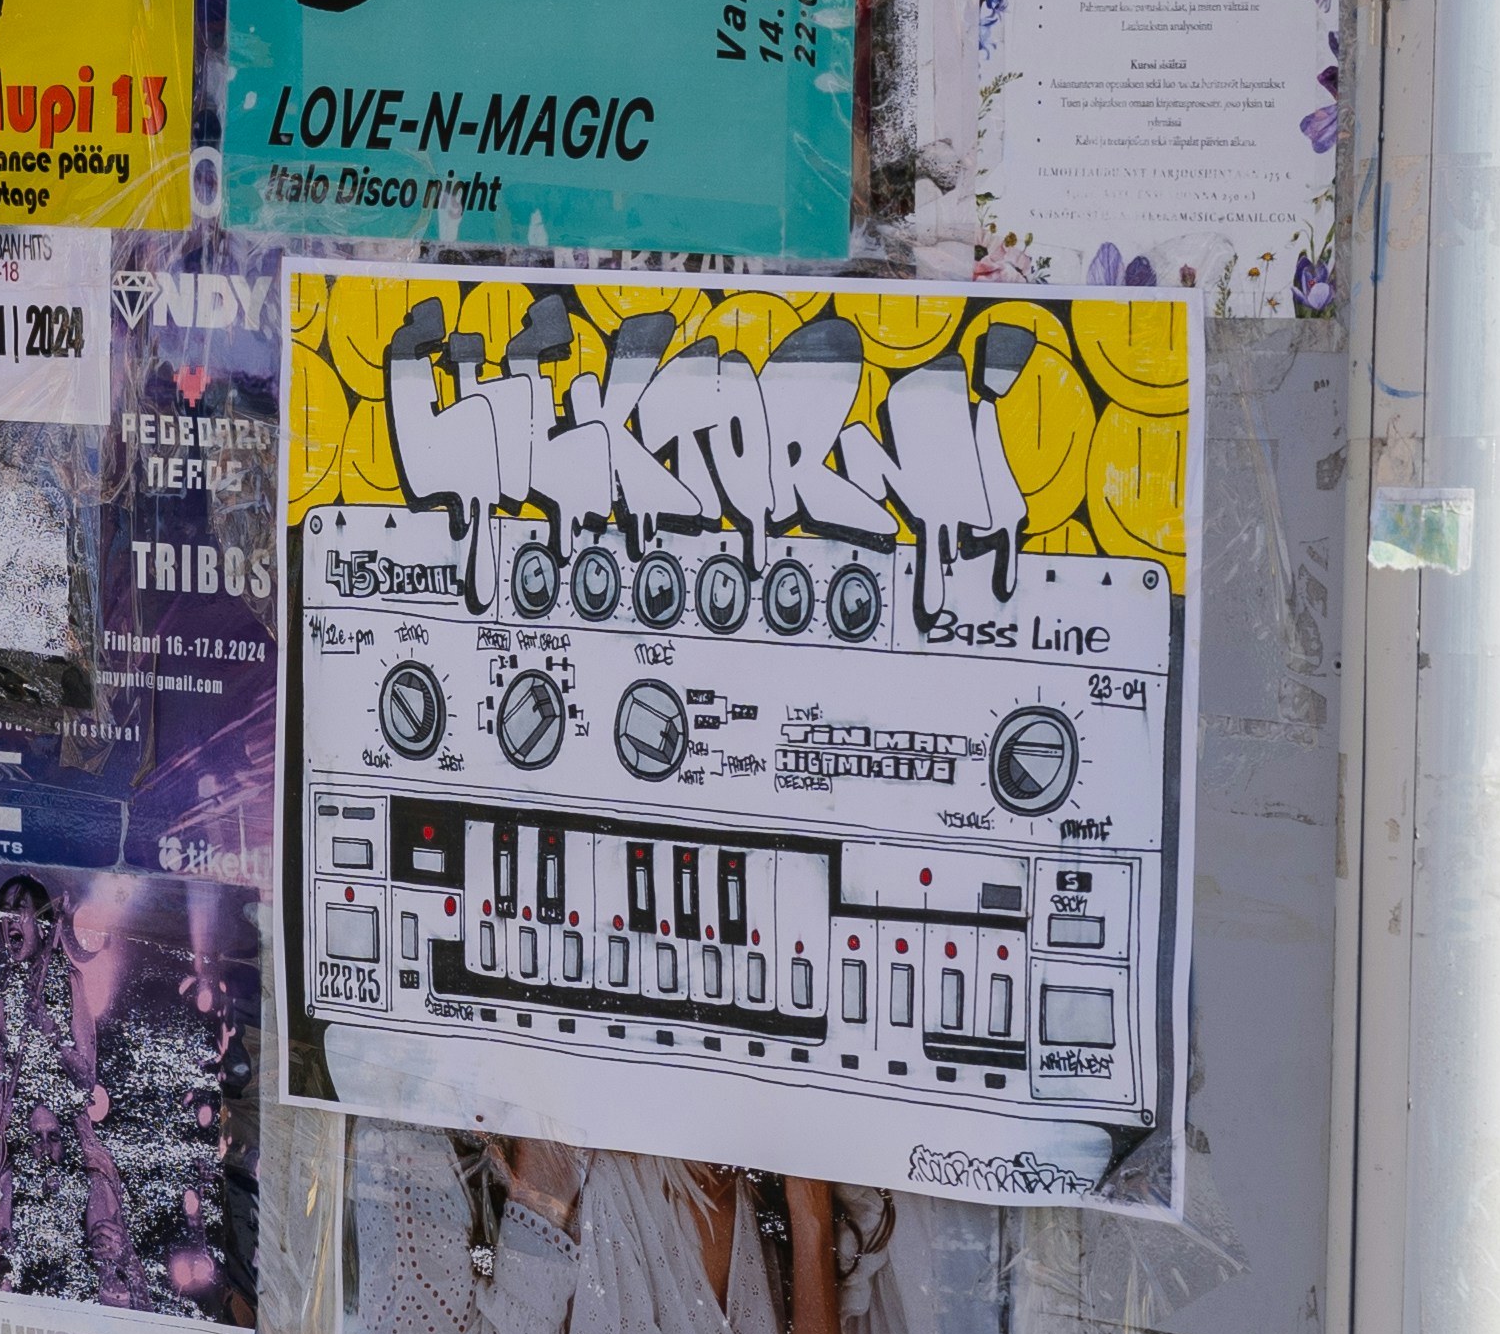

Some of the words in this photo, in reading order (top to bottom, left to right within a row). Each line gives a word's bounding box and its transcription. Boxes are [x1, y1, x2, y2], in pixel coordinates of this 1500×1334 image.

[111, 74, 168, 137] 13
[267, 84, 655, 162] LOVE-N-MAGIC
[58, 144, 131, 184] pääsy
[266, 164, 331, 207] Italo
[335, 166, 418, 211] Disco
[422, 171, 502, 217] night
[24, 305, 84, 358] 2024
[131, 540, 272, 599] TRIBOS
[325, 549, 378, 598] 45
[377, 555, 465, 597] SPECIAL
[103, 629, 161, 655] Finland
[165, 635, 266, 663] 16.-17.8.2024
[927, 609, 1018, 648] Bass
[1031, 616, 1111, 656] Line
[874, 731, 968, 757] MAN
